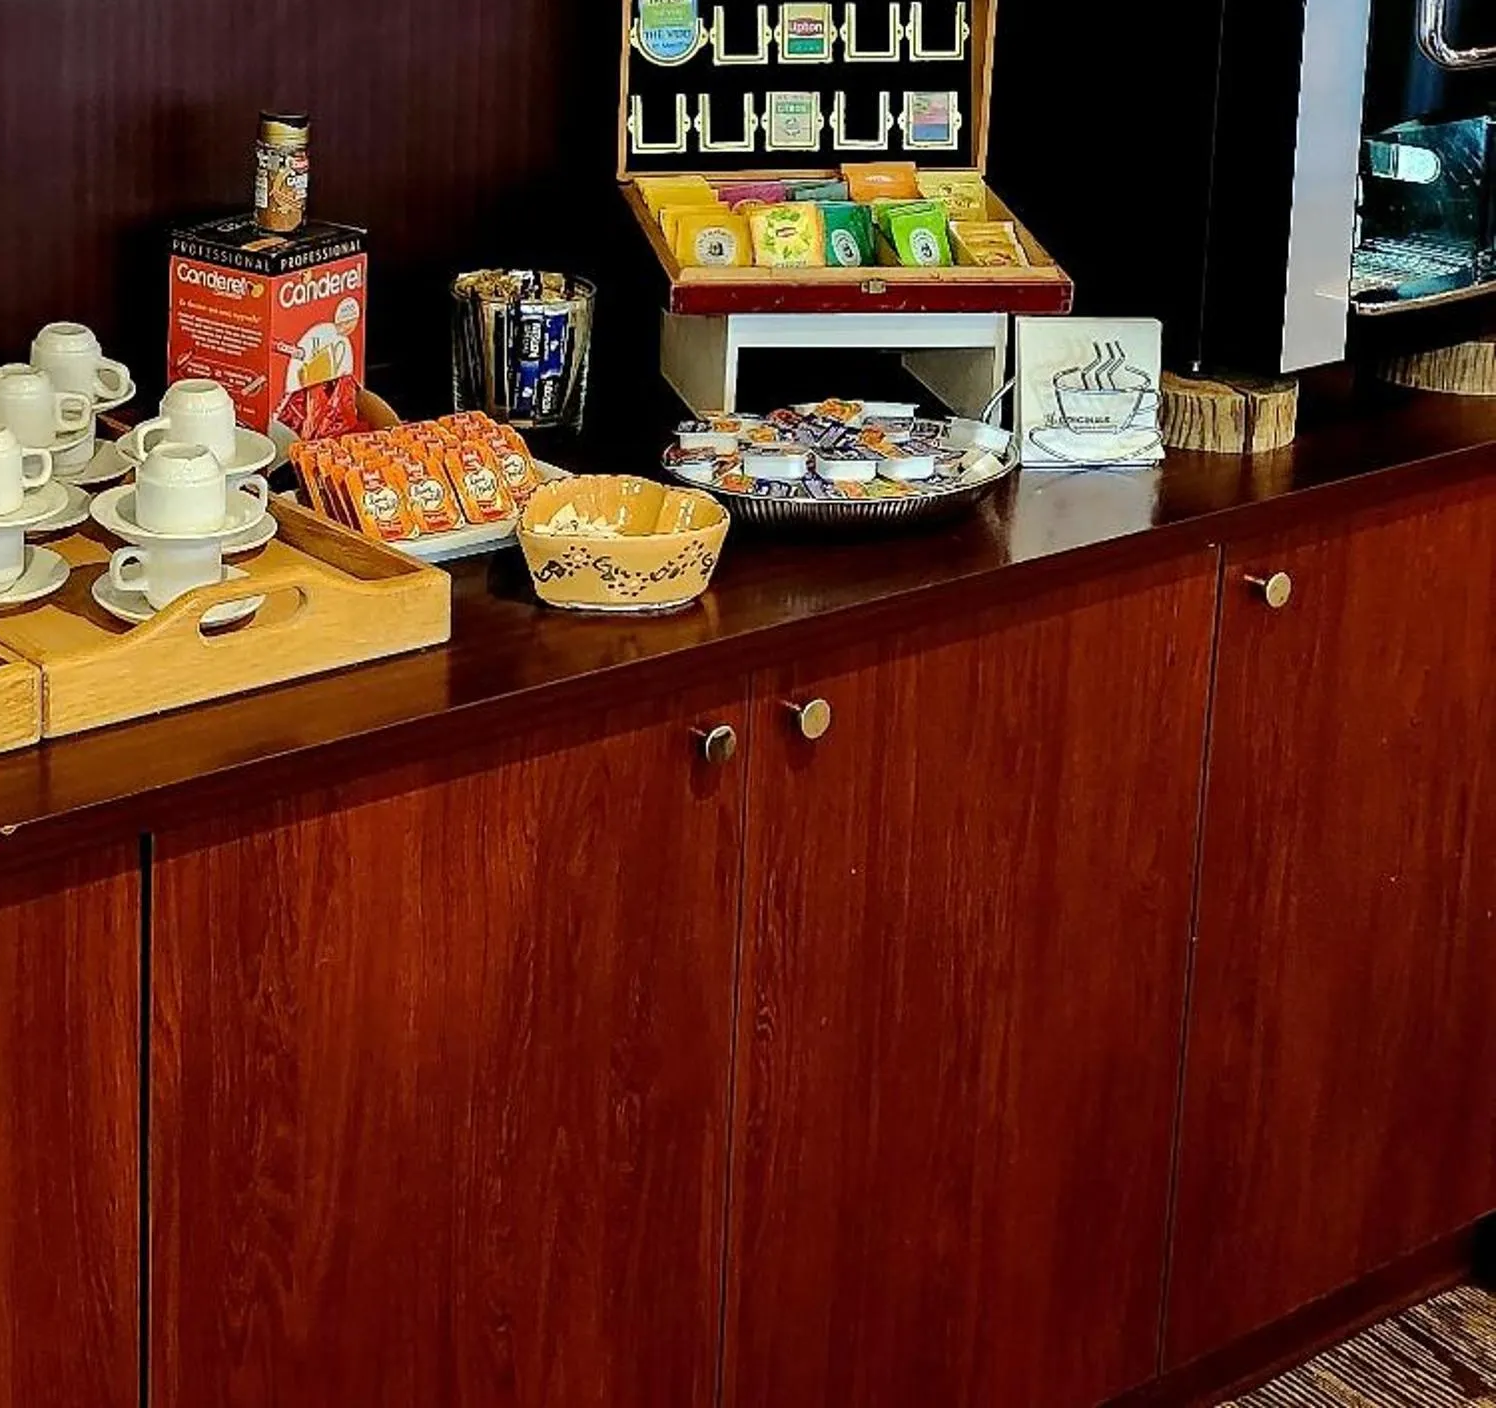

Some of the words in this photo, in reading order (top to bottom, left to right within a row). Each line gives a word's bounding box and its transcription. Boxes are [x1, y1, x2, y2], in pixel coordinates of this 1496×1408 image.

[172, 238, 271, 273] PROFESSIONAL
[280, 238, 362, 272] PROFESSIONAL
[177, 263, 248, 296] Canderel
[279, 262, 363, 309] Canderel
